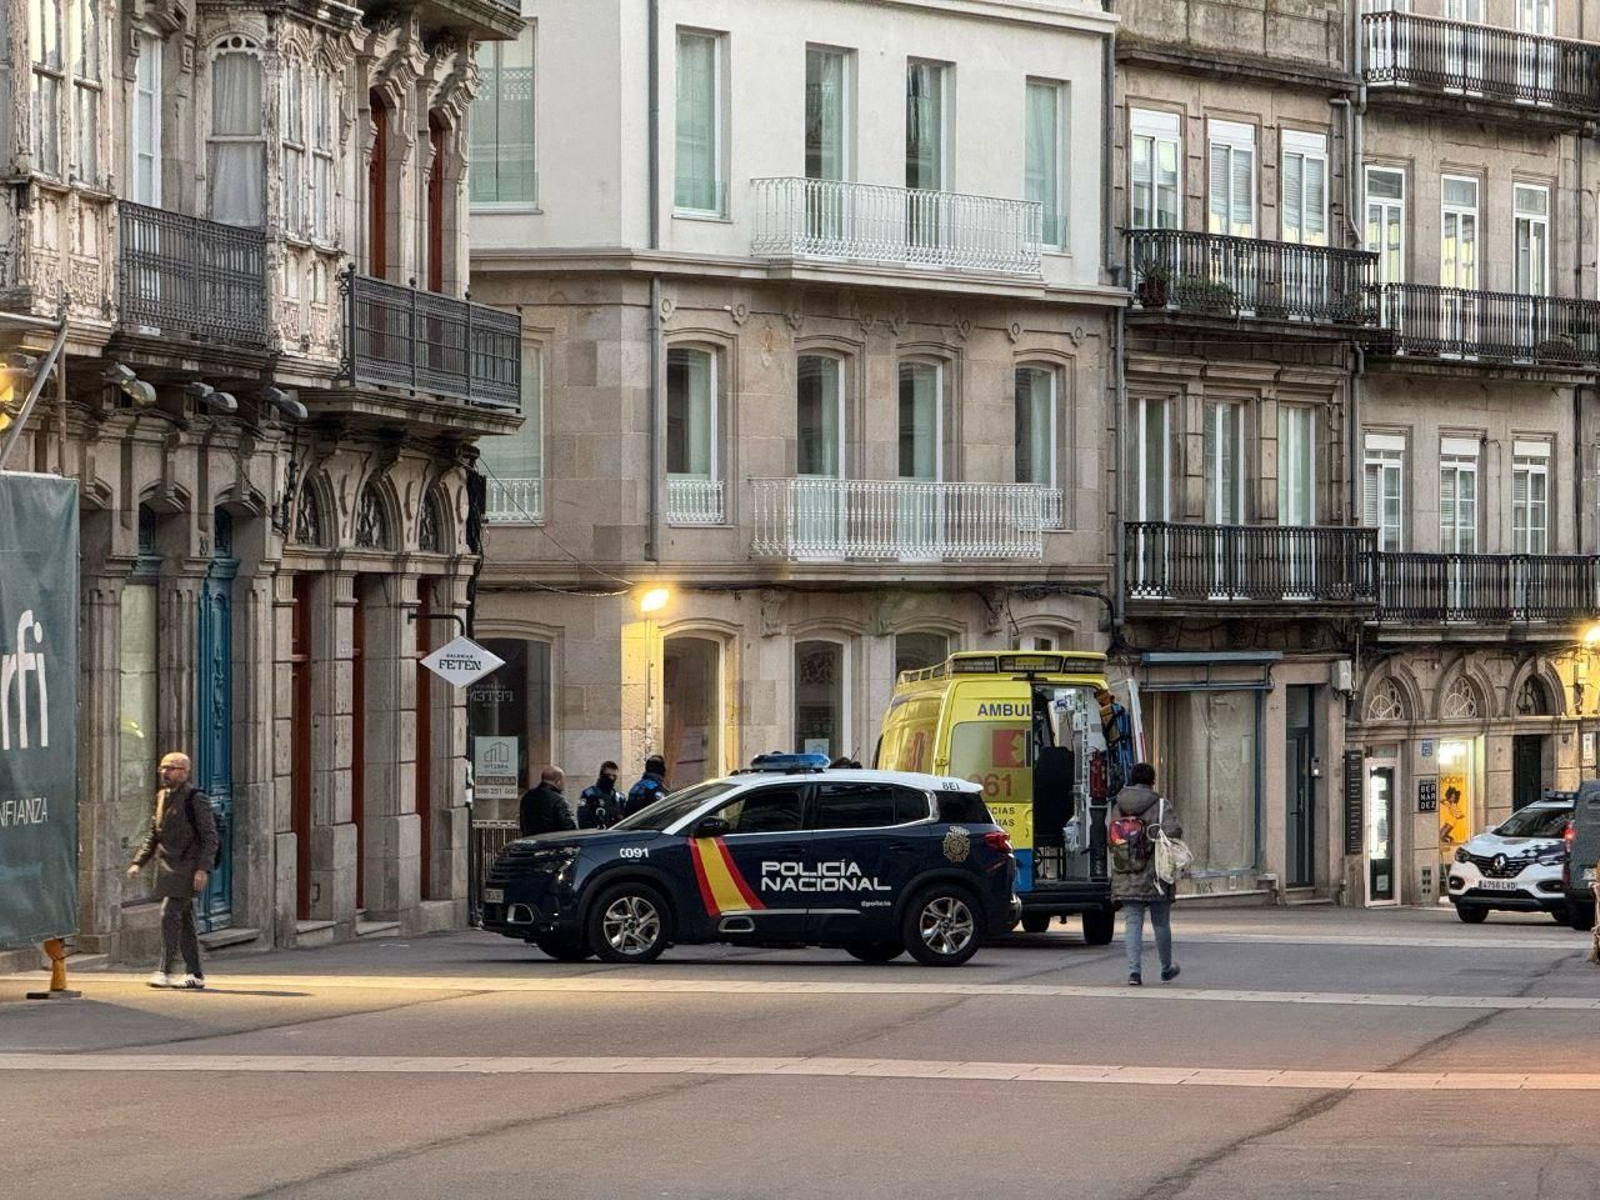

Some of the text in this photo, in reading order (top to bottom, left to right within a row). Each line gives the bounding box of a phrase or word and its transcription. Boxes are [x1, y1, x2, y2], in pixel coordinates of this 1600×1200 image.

[969, 773, 1012, 797] 61
[990, 807, 1016, 816] CIAS
[761, 859, 862, 877] POLICÍA
[760, 877, 892, 892] NACIONAL
